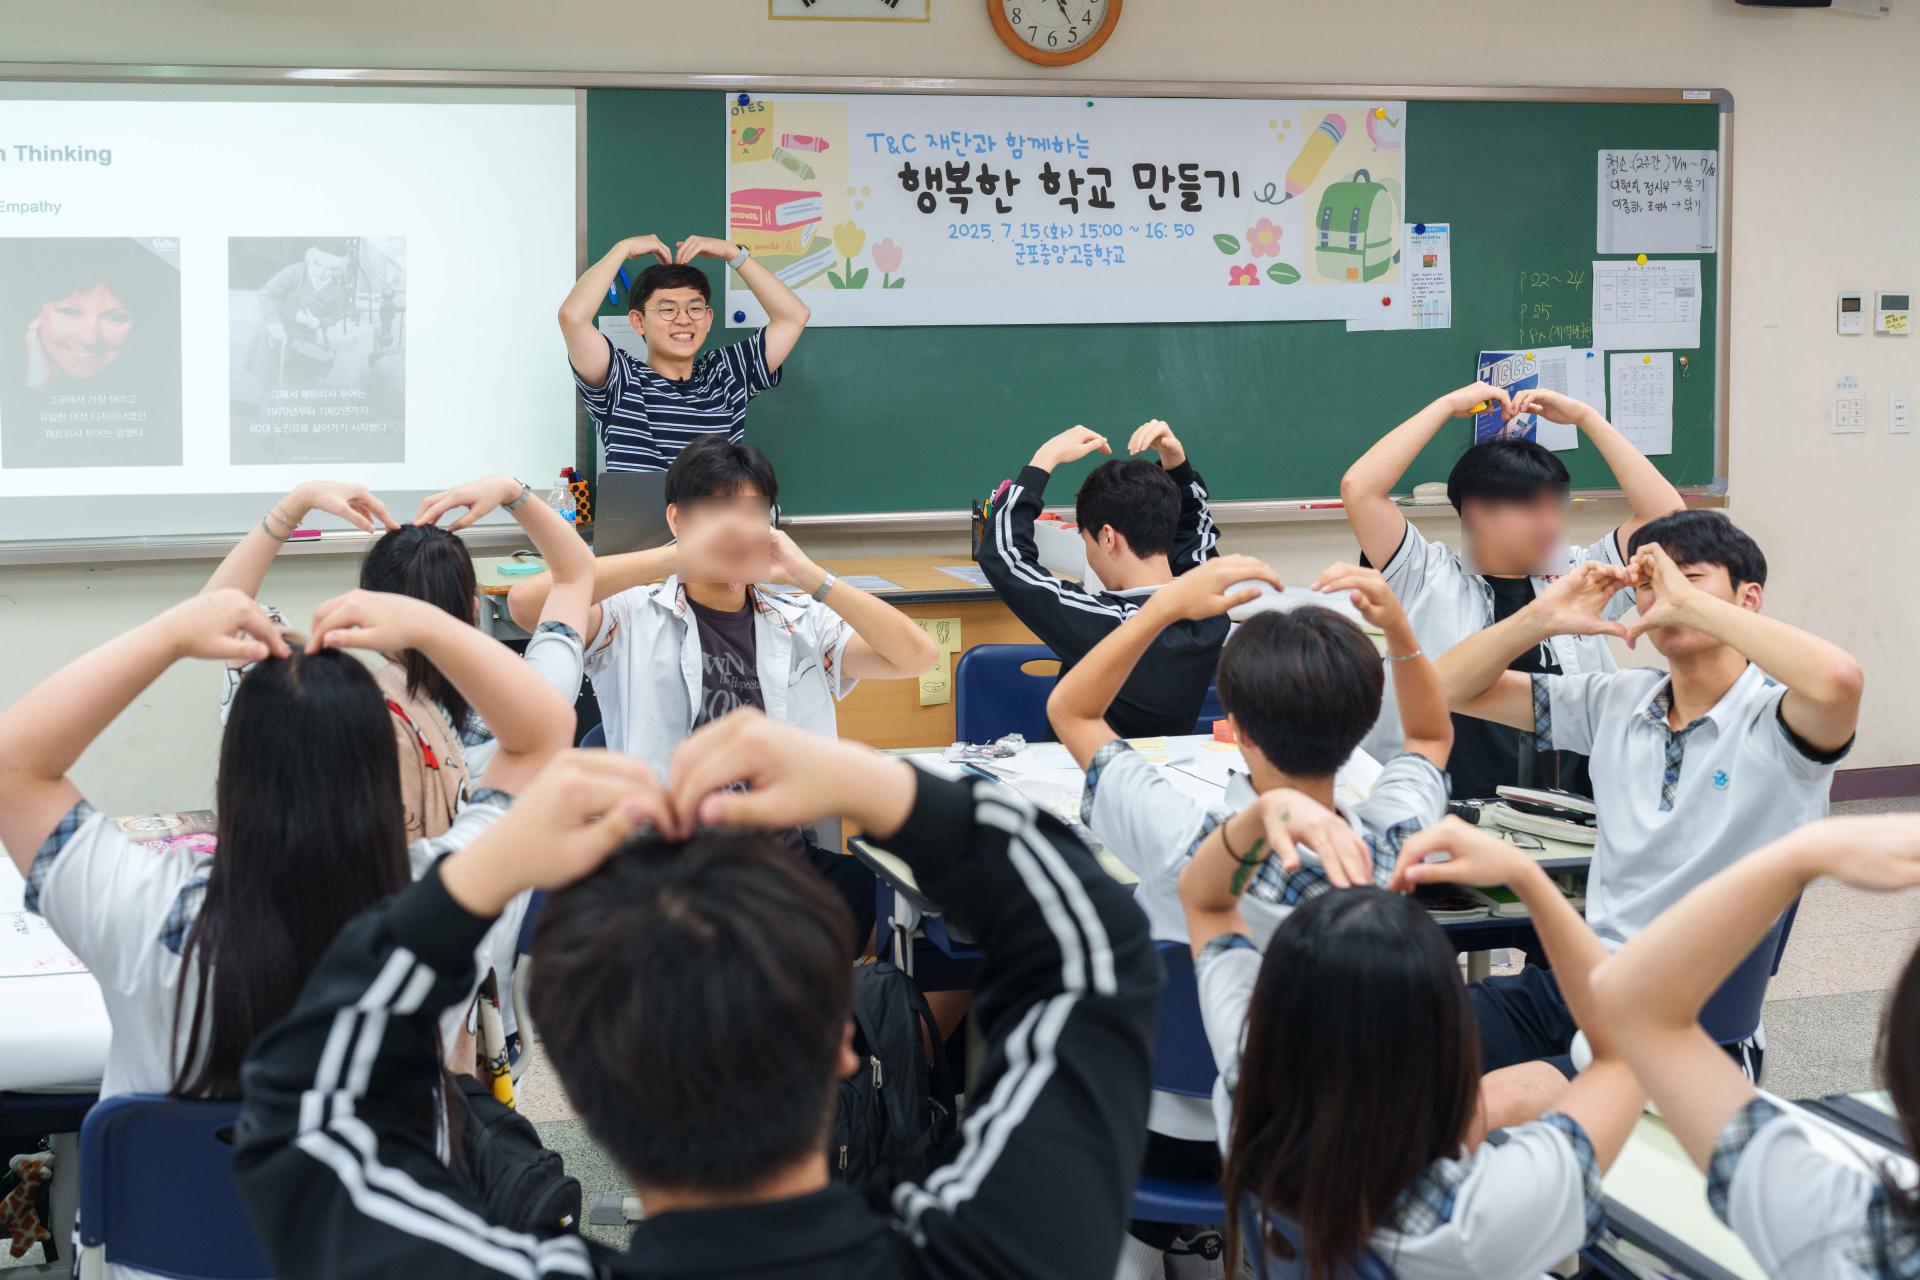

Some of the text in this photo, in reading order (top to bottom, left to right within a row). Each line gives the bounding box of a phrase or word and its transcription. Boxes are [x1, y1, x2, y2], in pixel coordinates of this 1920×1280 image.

[1012, 8, 1021, 24] 8
[1082, 10, 1092, 25] 4
[1028, 26, 1038, 42] 7
[1047, 31, 1057, 47] 6
[1068, 27, 1077, 43] 5
[866, 131, 1090, 159] T&C 재단과 함께하는
[14, 145, 112, 166] Thinking
[898, 161, 1241, 214] 행복한 학교 만들기
[948, 223, 994, 243] 2025.
[1001, 223, 1015, 243] 7.
[1080, 223, 1123, 238] 15:00
[1014, 243, 1126, 266] 군포중앙고등학교
[1567, 270, 1584, 291] 24
